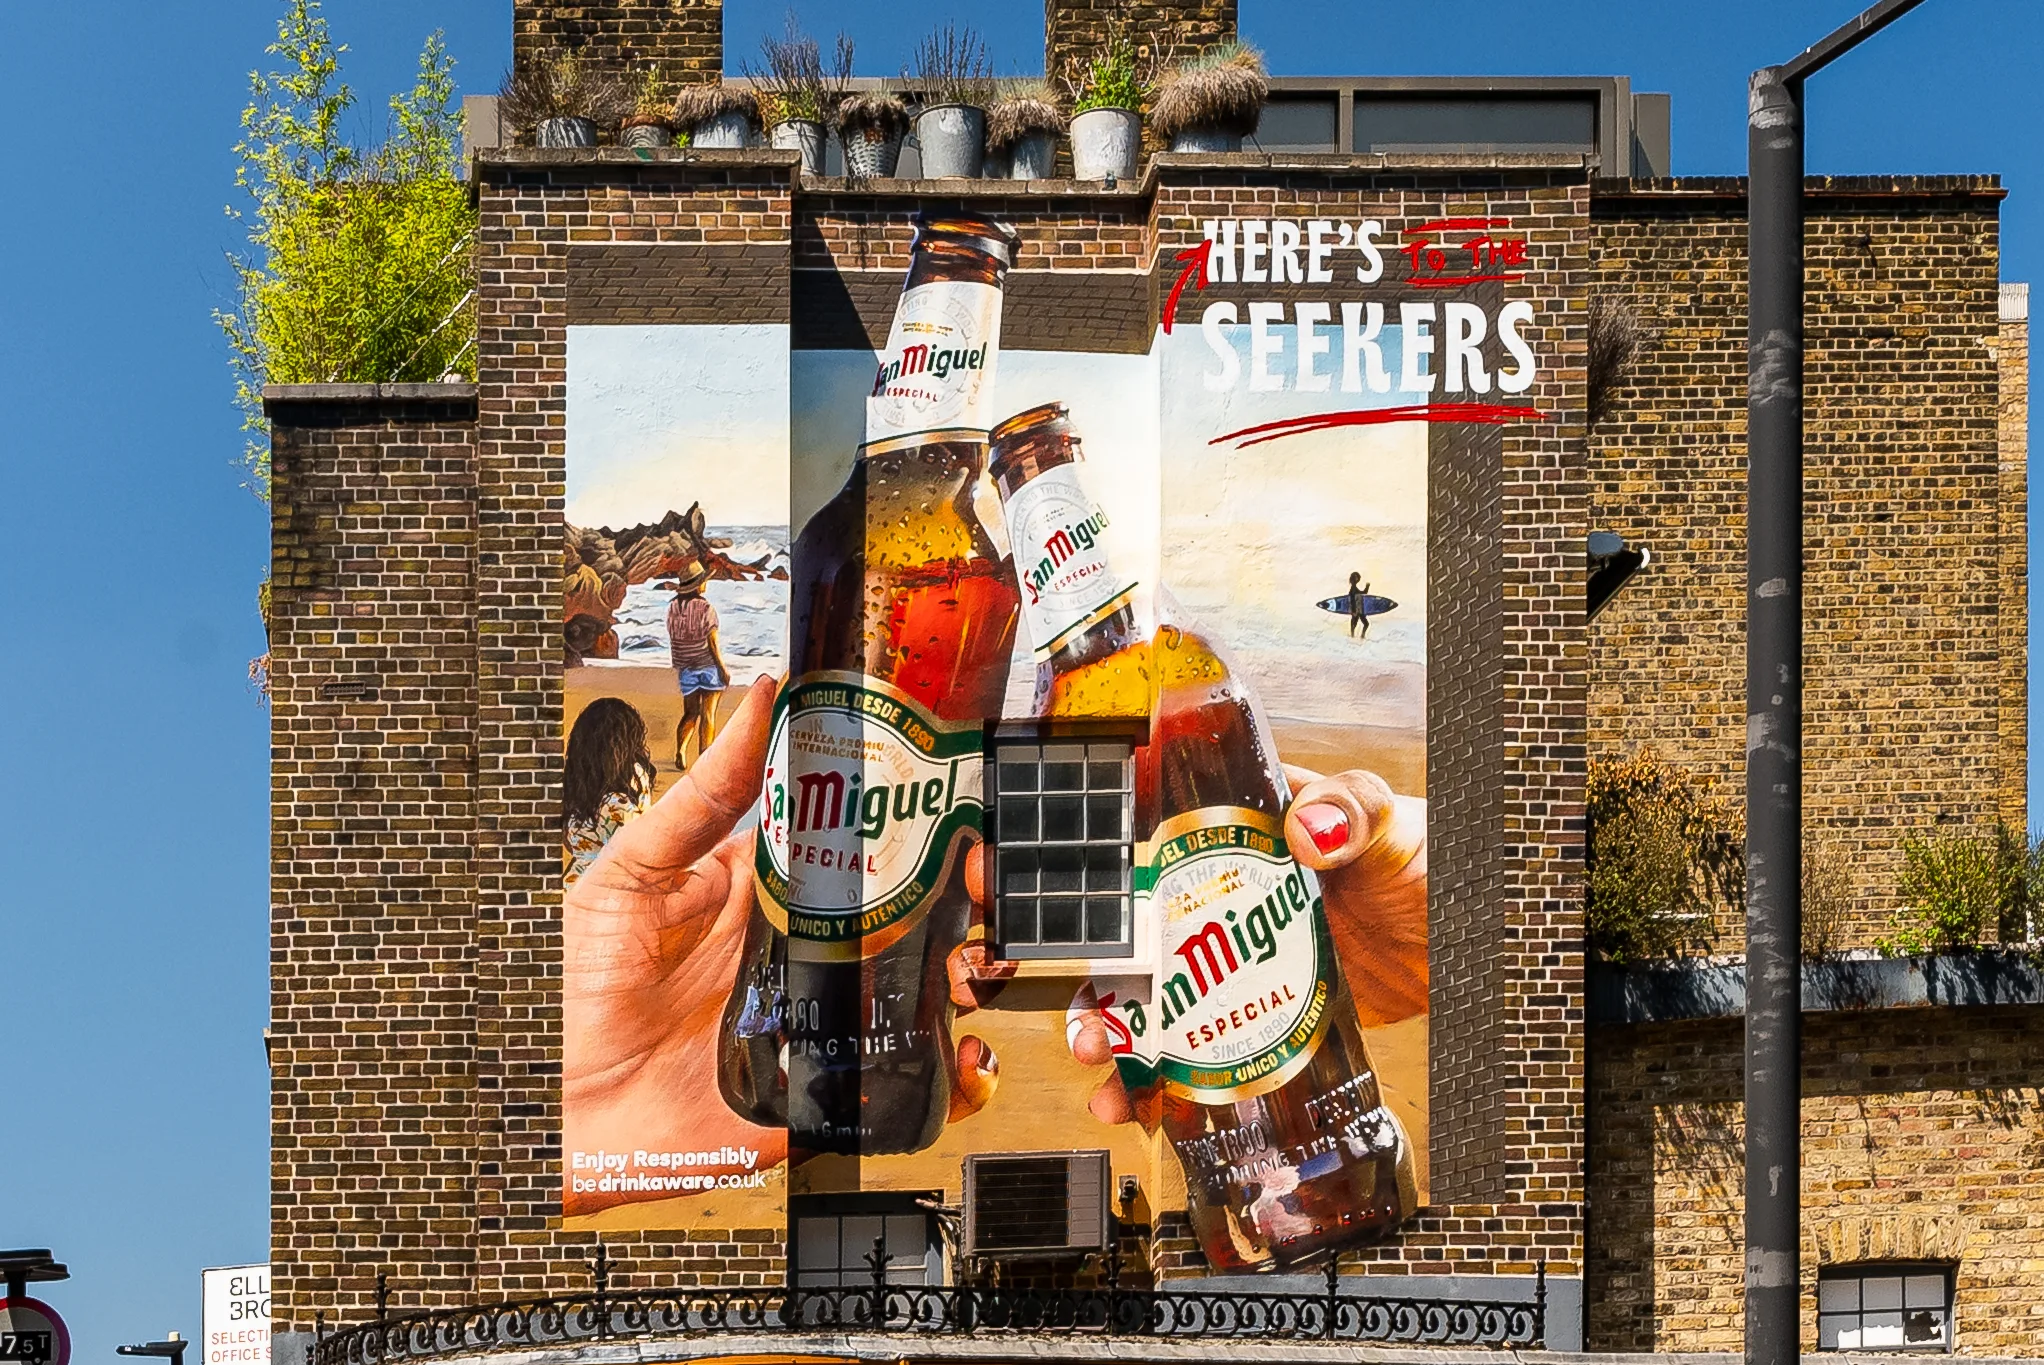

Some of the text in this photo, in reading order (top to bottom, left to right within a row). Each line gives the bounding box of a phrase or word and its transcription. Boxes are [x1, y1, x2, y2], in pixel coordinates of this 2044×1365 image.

[1203, 220, 1384, 284] HERE'S
[1462, 236, 1528, 268] THE
[1201, 301, 1537, 394] SEEKERS
[887, 386, 938, 402] ESPECIAL
[1054, 561, 1105, 591] ESPECIAL
[801, 690, 935, 752] MIGUEL DESDE 1890
[1186, 827, 1236, 852] DESDE
[766, 870, 789, 905] SABO
[836, 920, 845, 935] Y
[1186, 985, 1295, 1050] ESPECIAL
[1212, 1012, 1290, 1060] SINCE 1890
[1277, 1044, 1290, 1058] Y
[572, 1146, 759, 1172] Enjoy Responsibly
[212, 1348, 260, 1363] OFFICE
